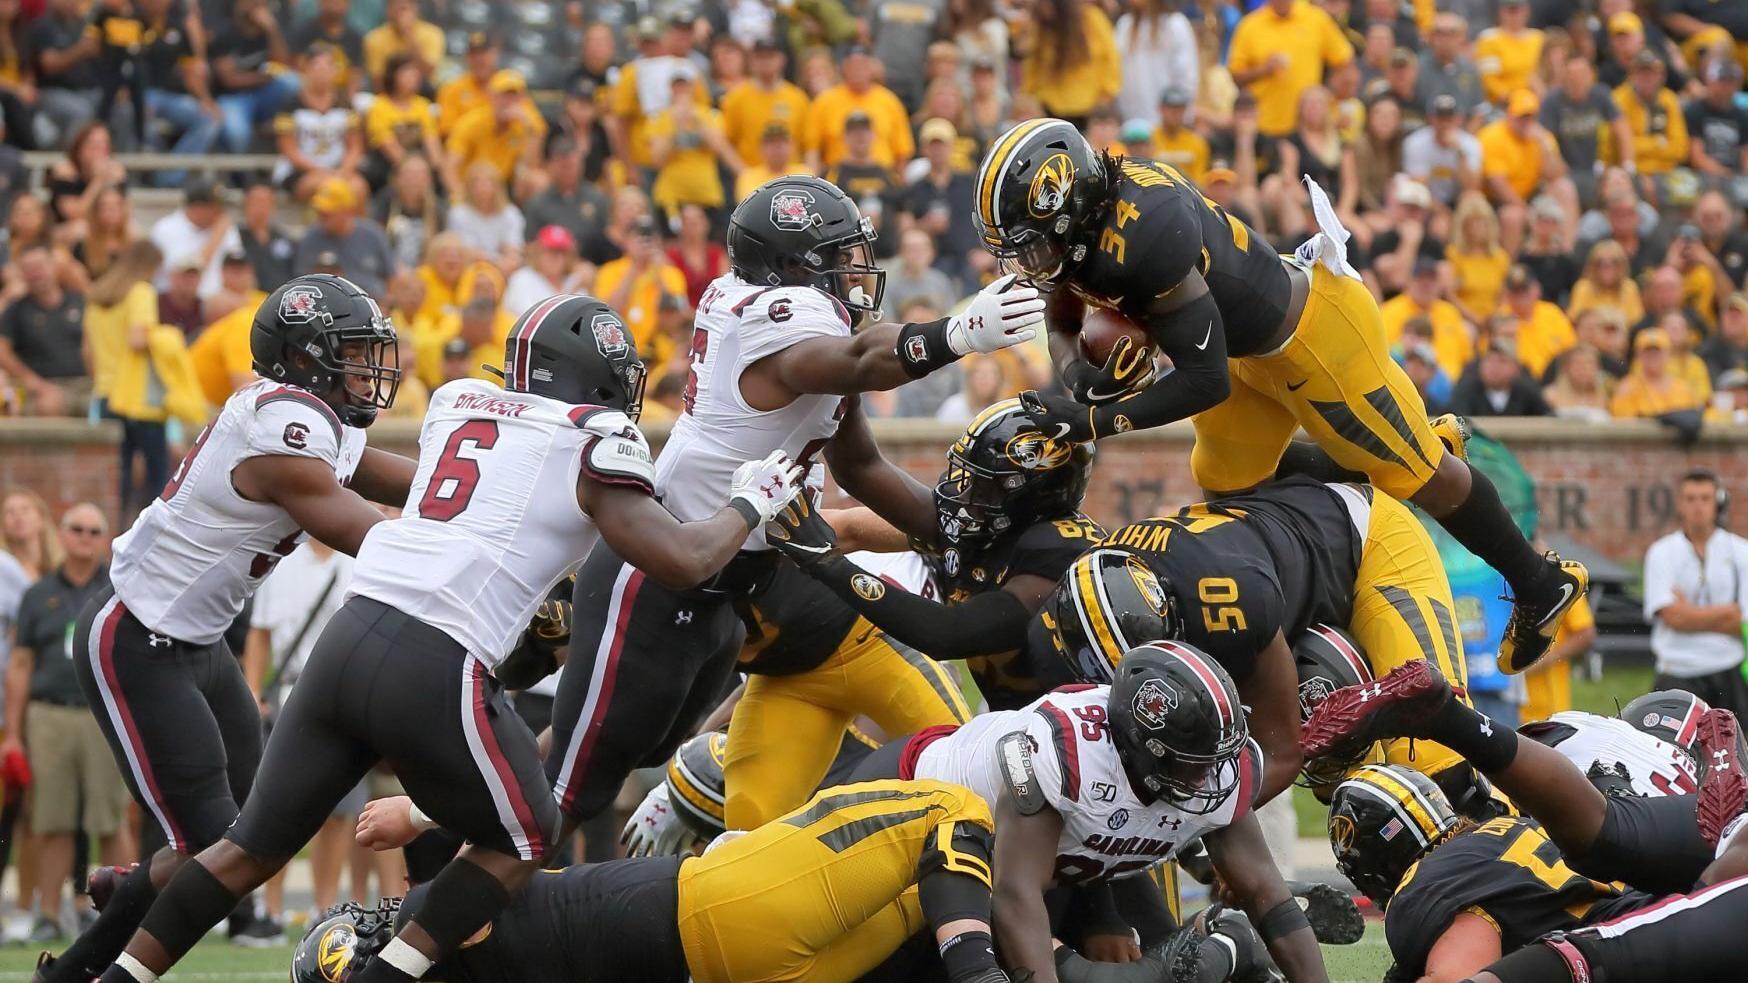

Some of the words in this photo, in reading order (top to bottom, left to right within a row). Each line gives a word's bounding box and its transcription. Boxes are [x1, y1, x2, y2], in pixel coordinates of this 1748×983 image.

[1099, 199, 1143, 264] 34
[419, 419, 500, 522] 6
[1556, 482, 1589, 530] R
[1092, 525, 1172, 552] WHIT
[1198, 577, 1248, 632] 50
[1072, 705, 1111, 744] 95
[1082, 833, 1175, 856] CAROLINA
